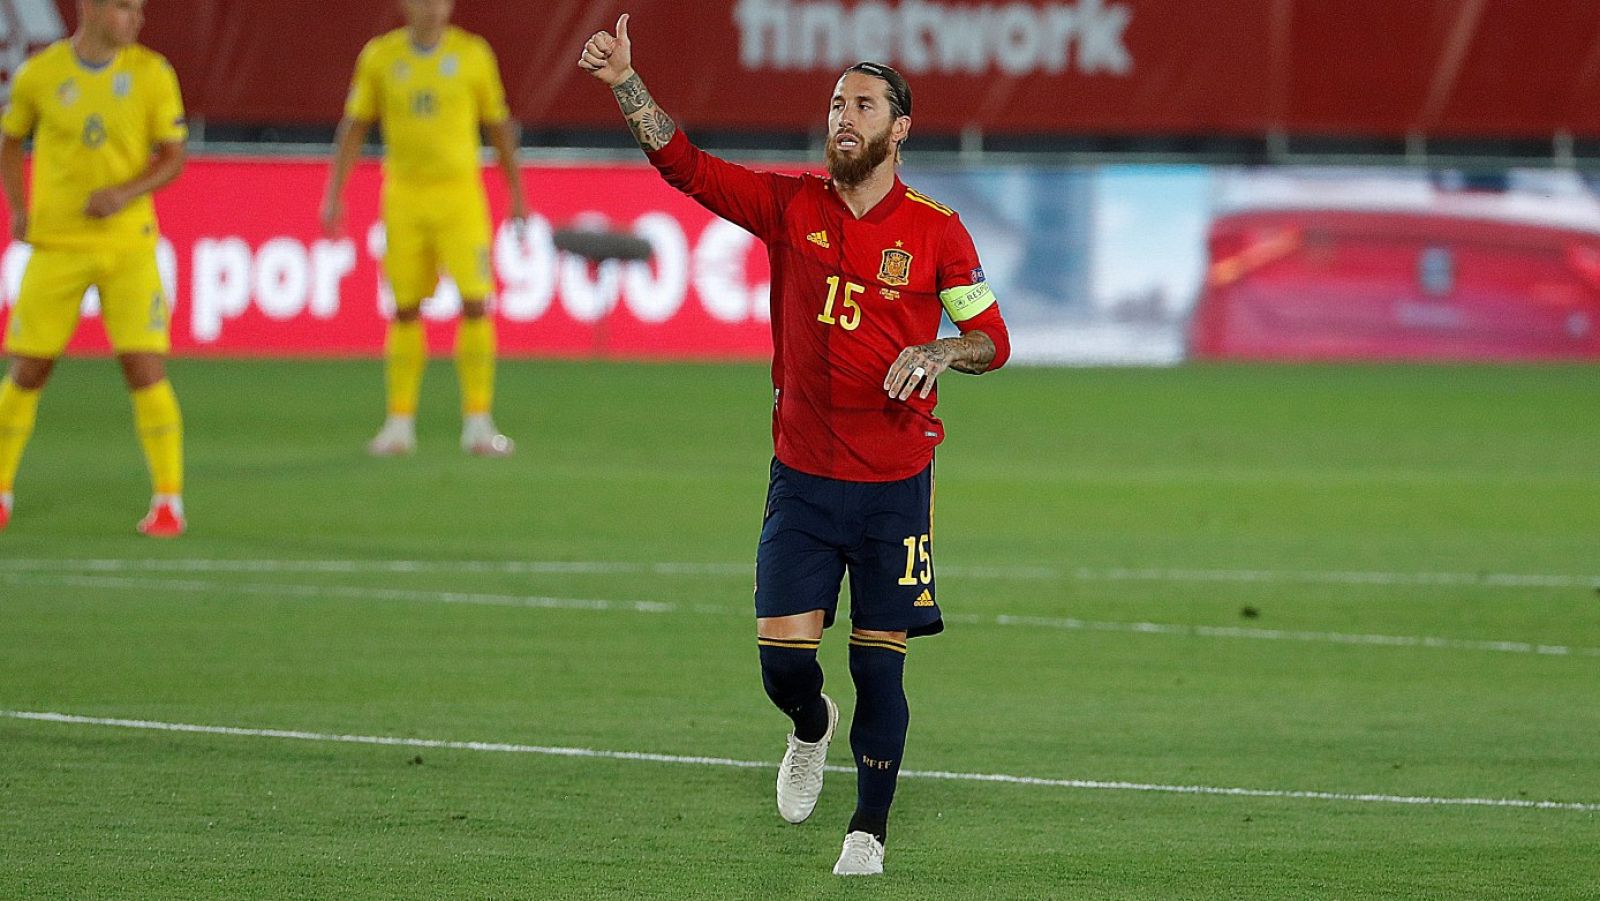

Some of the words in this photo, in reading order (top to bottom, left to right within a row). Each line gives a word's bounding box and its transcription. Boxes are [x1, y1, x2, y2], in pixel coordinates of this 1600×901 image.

[734, 0, 1134, 74] finetwork
[190, 235, 357, 343] por
[817, 275, 865, 331] 15
[898, 534, 932, 586] 15
[862, 755, 893, 769] RFEF
